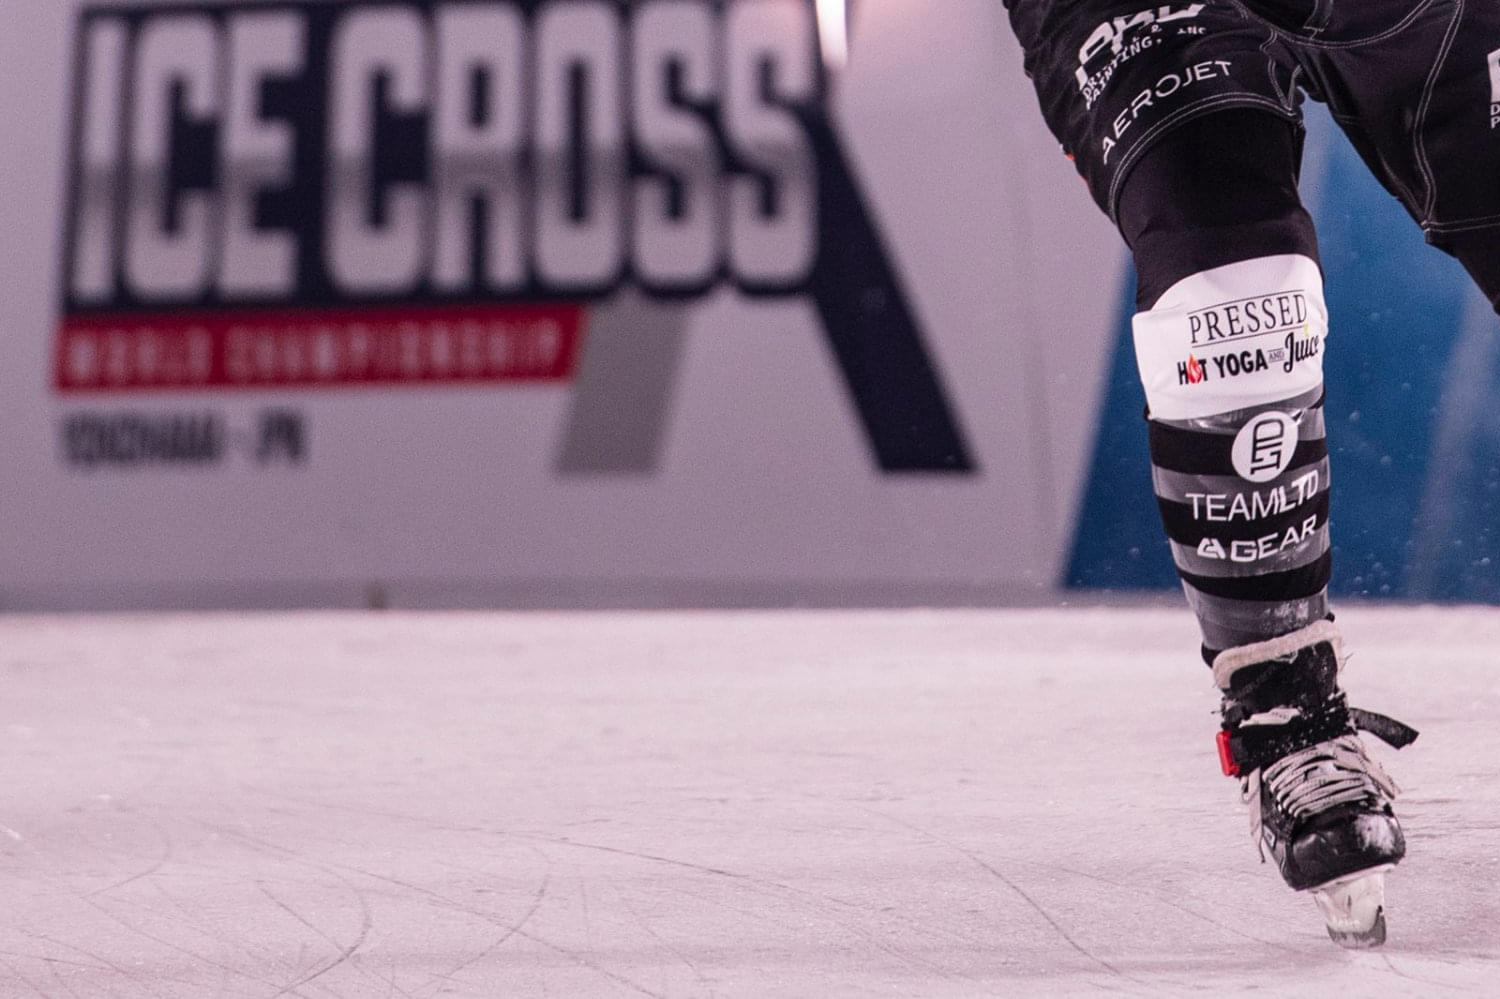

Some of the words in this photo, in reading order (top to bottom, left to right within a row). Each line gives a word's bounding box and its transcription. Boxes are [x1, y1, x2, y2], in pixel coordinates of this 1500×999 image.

[1103, 60, 1233, 166] AEROJET
[66, 10, 304, 303] ICE
[1188, 294, 1307, 344] PRESSED
[1177, 353, 1208, 385] HOT
[1213, 349, 1268, 378] YOGA
[1283, 331, 1320, 373] Juice
[1185, 469, 1320, 521] TEAMLTD
